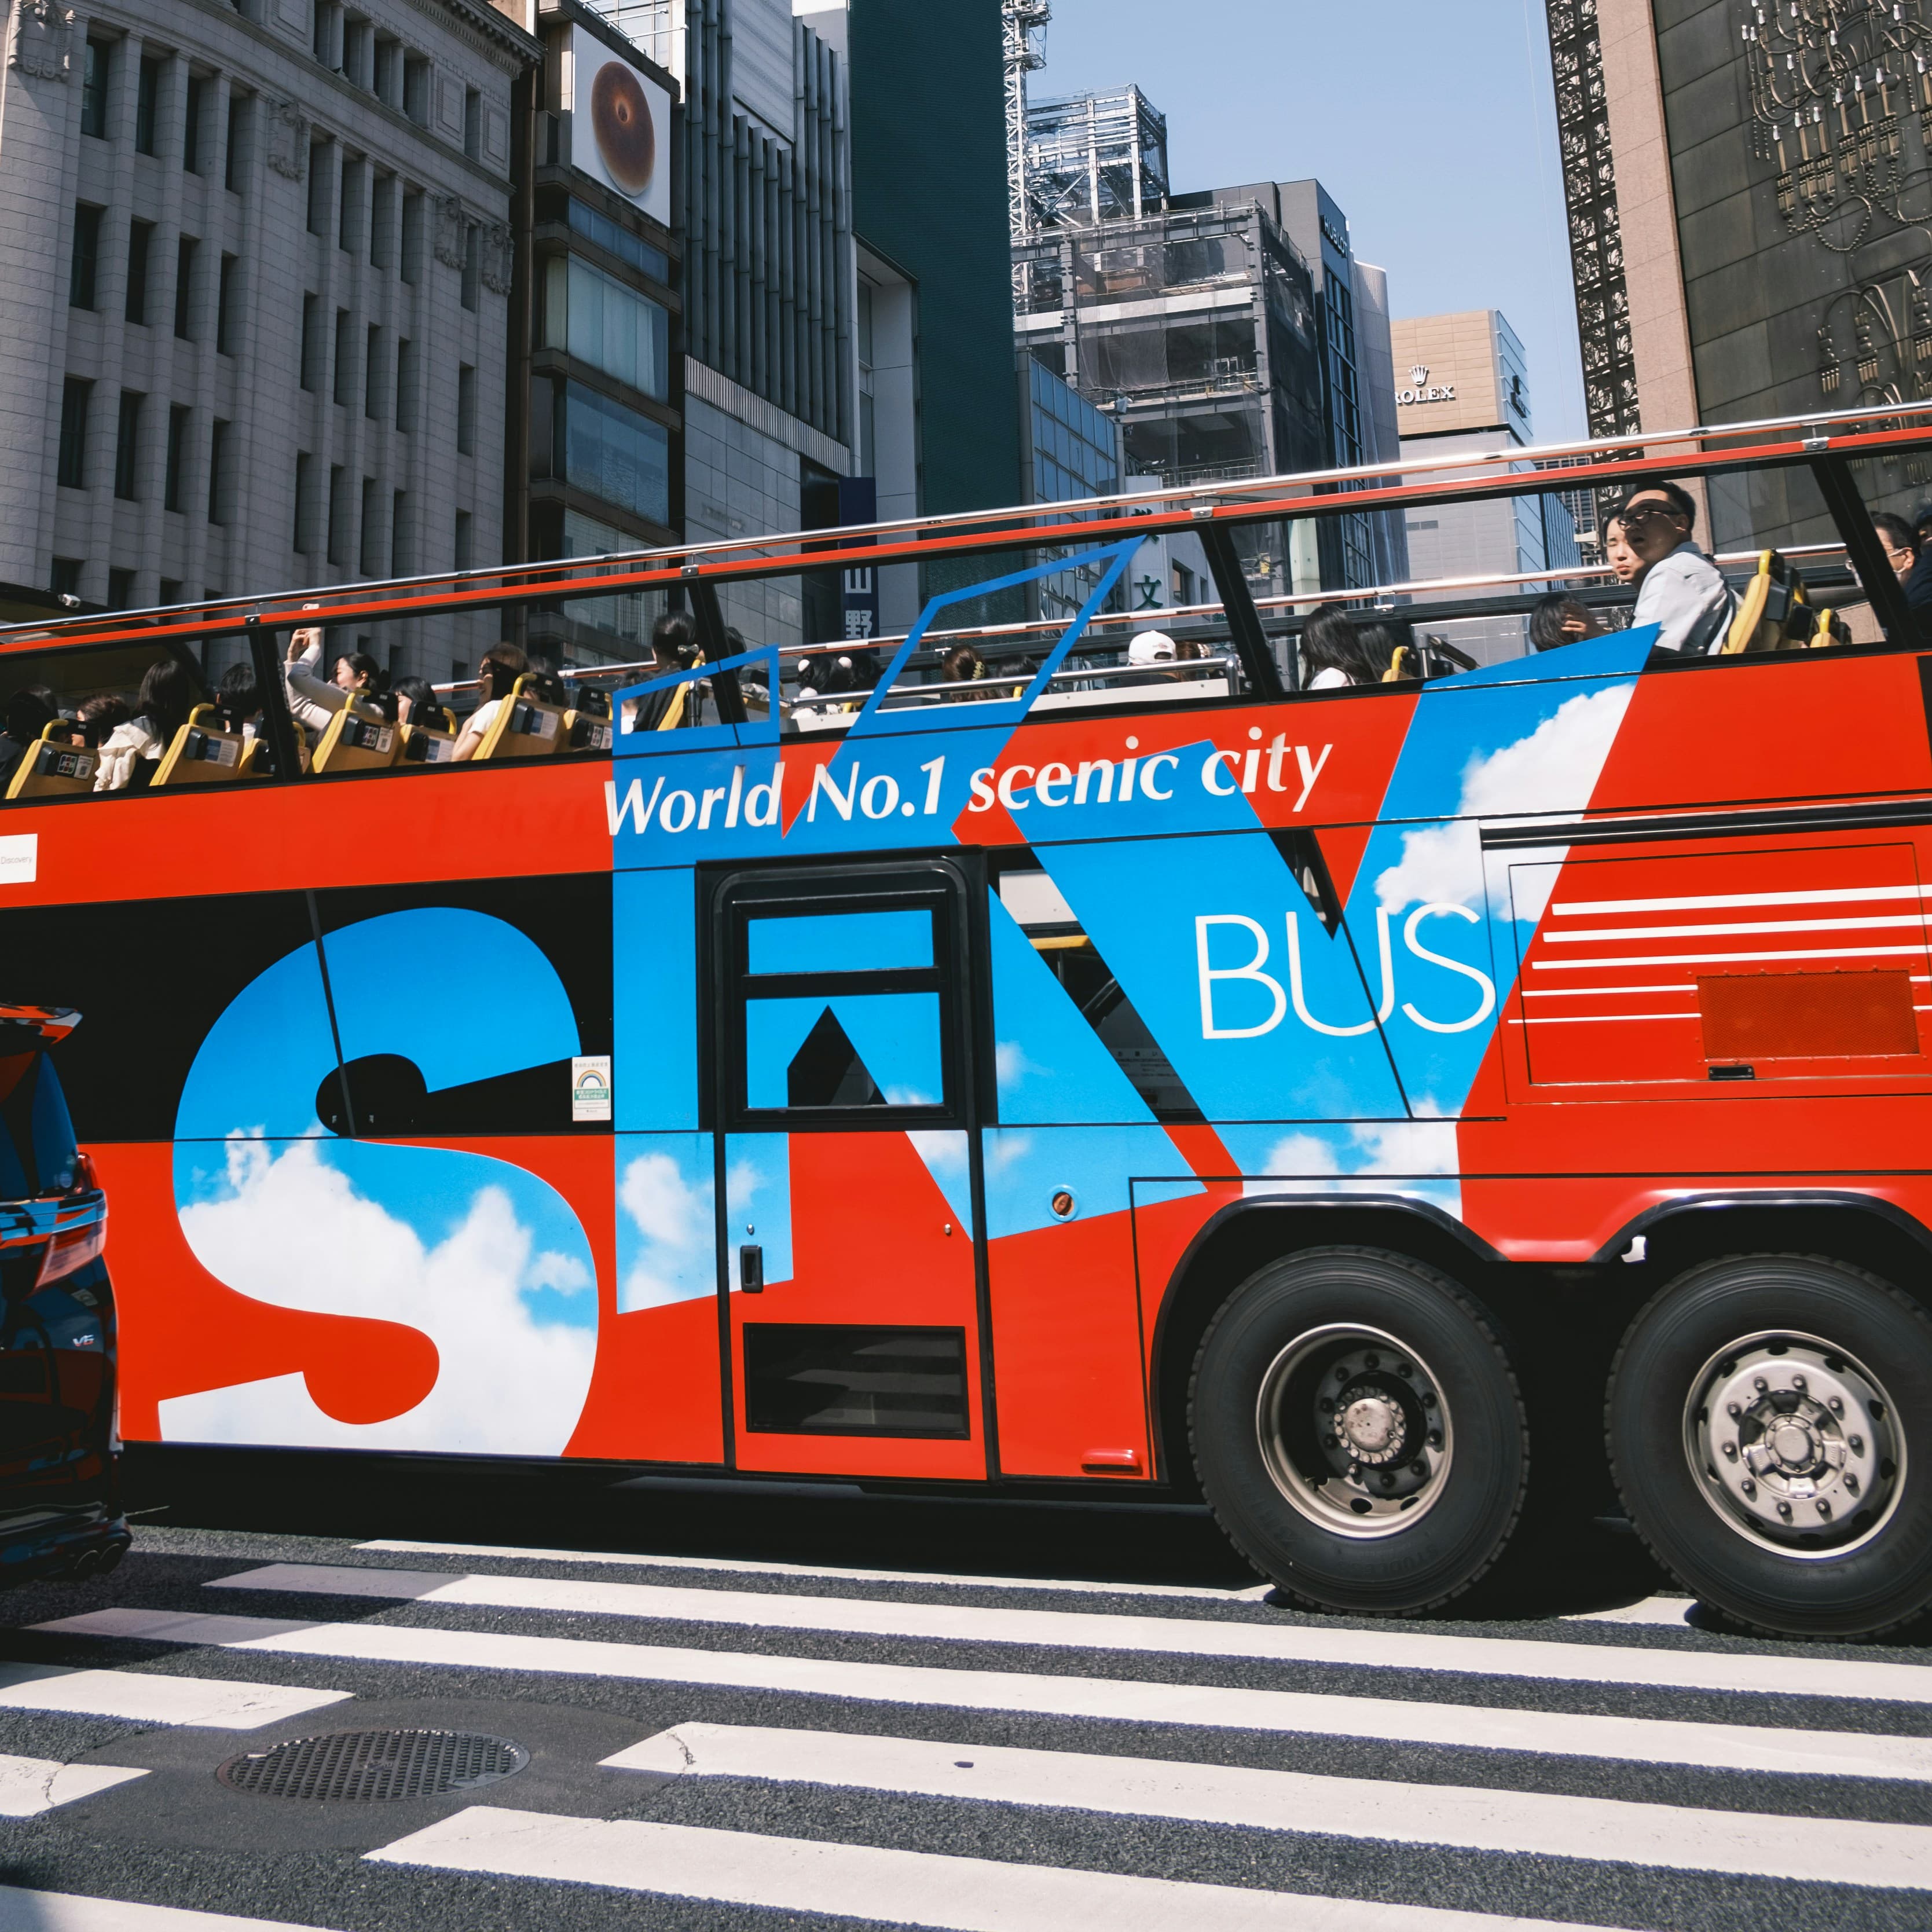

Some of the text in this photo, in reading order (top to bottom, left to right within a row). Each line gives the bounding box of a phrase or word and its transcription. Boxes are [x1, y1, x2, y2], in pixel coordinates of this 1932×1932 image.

[1321, 215, 1348, 258] HUBLOT
[845, 567, 872, 639] 山野
[604, 761, 785, 835] World
[807, 755, 945, 822] No.1
[967, 735, 1179, 812] scenic
[1201, 726, 1333, 812] city
[1195, 902, 1495, 1039] BUS
[72, 1334, 94, 1347] V6
